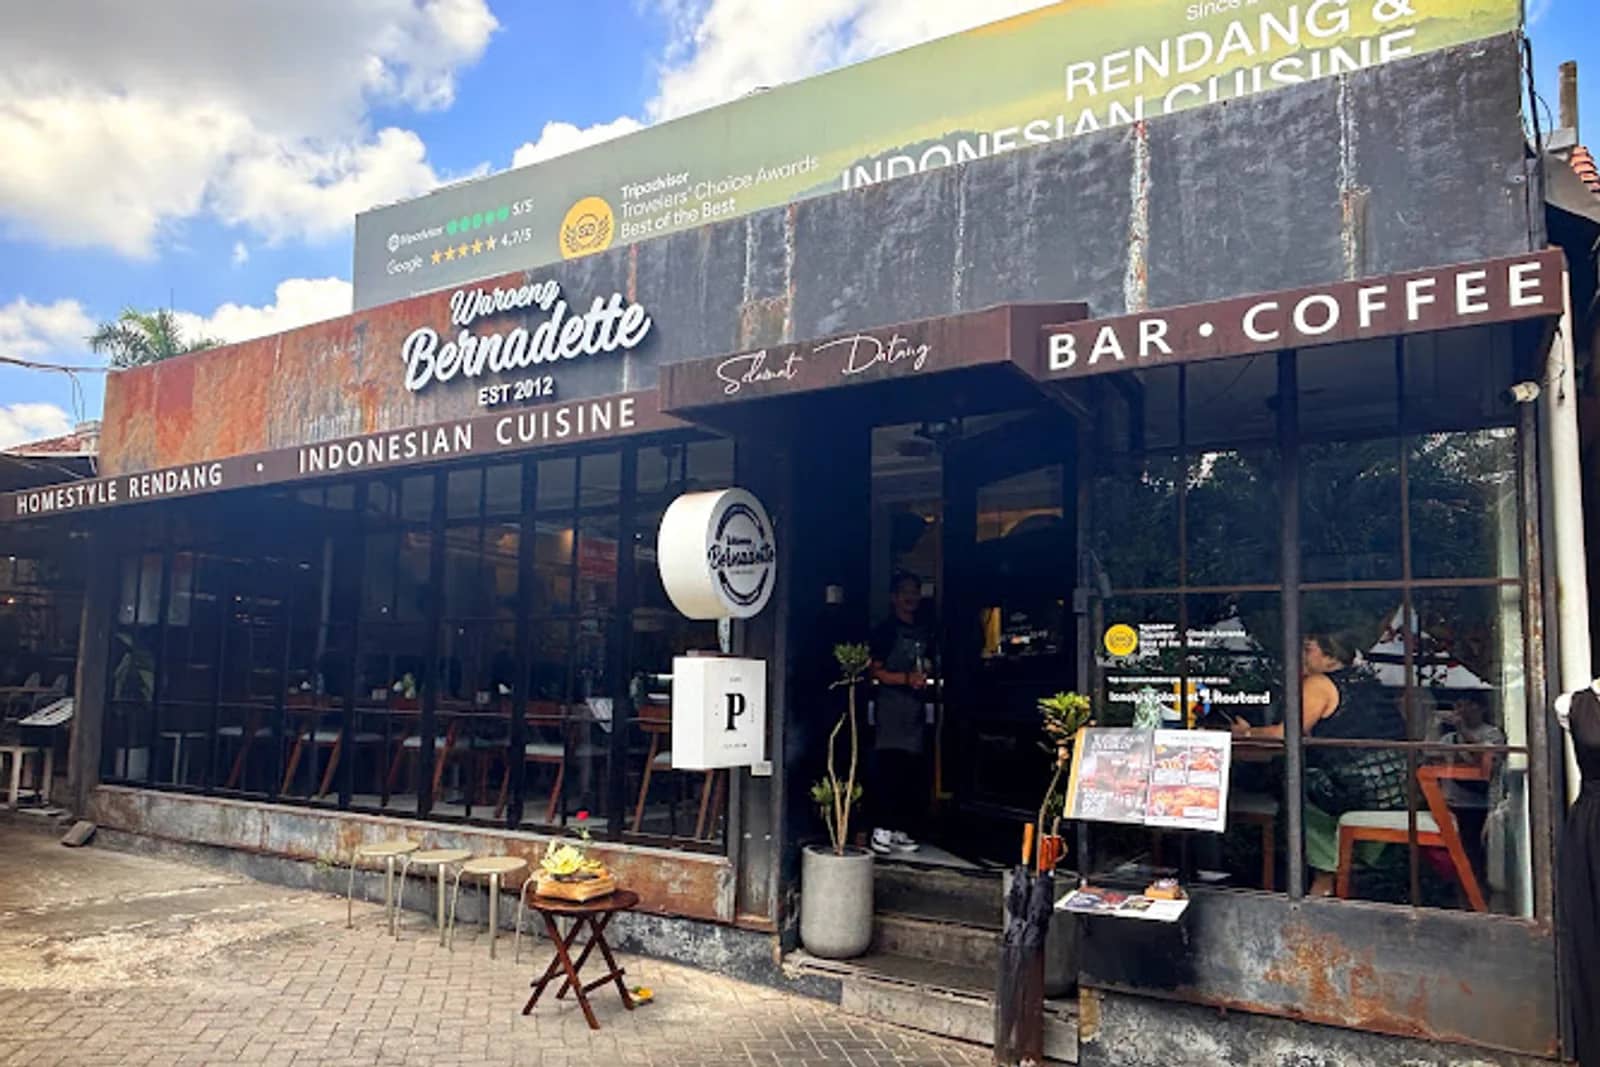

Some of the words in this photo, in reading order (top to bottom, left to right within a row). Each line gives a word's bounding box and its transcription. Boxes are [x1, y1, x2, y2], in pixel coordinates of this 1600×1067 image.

[1066, 0, 1351, 101] RENDANG
[621, 171, 689, 199] Tripadvisor
[695, 174, 752, 200] Choice
[755, 154, 819, 184] Awards
[512, 198, 534, 216] 5/5
[621, 218, 652, 238] Best
[655, 212, 672, 230] of
[673, 208, 699, 225] the
[702, 198, 736, 217] Best
[450, 279, 560, 325] Waroeng
[1048, 318, 1172, 370] BAR
[1242, 261, 1544, 342] COFFEE
[402, 292, 652, 391] Bernadette
[478, 386, 510, 405] EST
[514, 376, 554, 400] 2012
[16, 480, 117, 515] HOMESTYLE
[129, 463, 223, 498] RENDANG
[299, 423, 473, 473] INDONESIAN
[496, 398, 636, 445] CUISINE
[725, 692, 746, 731] P
